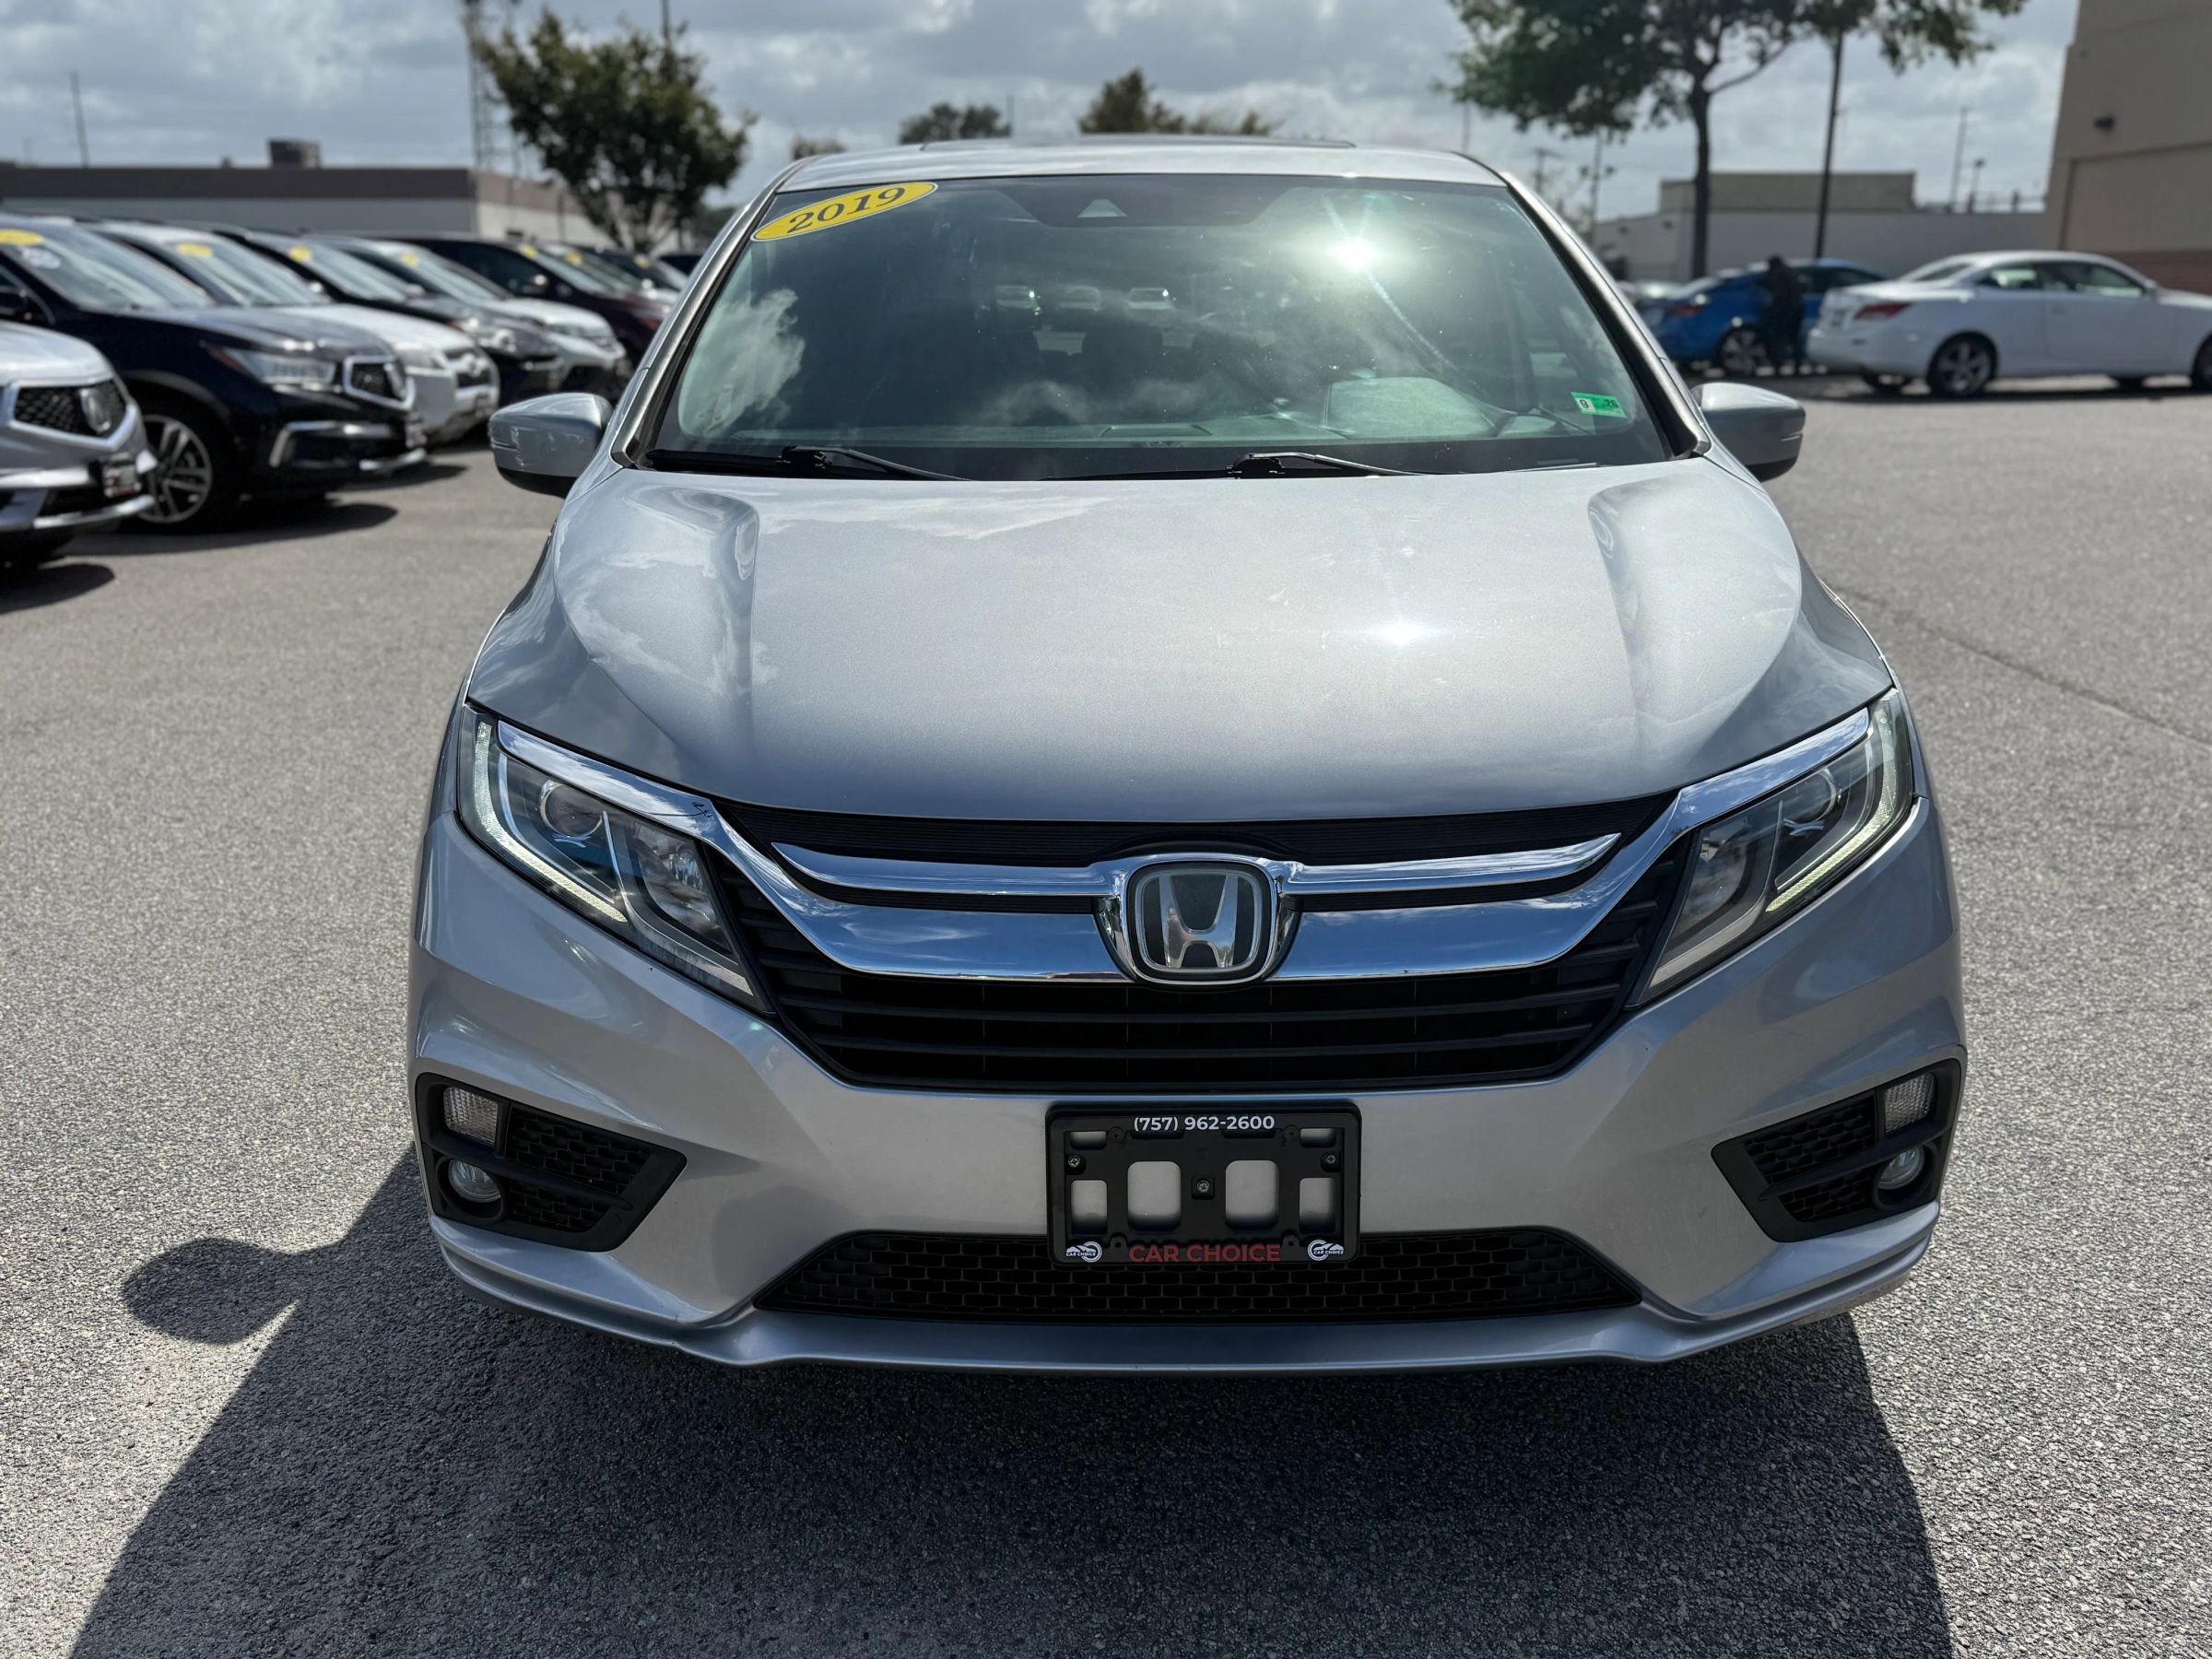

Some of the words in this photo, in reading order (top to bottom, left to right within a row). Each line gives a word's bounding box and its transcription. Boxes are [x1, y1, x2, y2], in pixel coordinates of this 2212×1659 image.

[787, 187, 905, 233] 2019
[1579, 399, 1589, 409] 9
[1134, 1116, 1179, 1132] (757)
[1184, 1115, 1275, 1131] 962-2600
[1129, 1245, 1181, 1264] CAR
[1185, 1244, 1281, 1263] CHOICE
